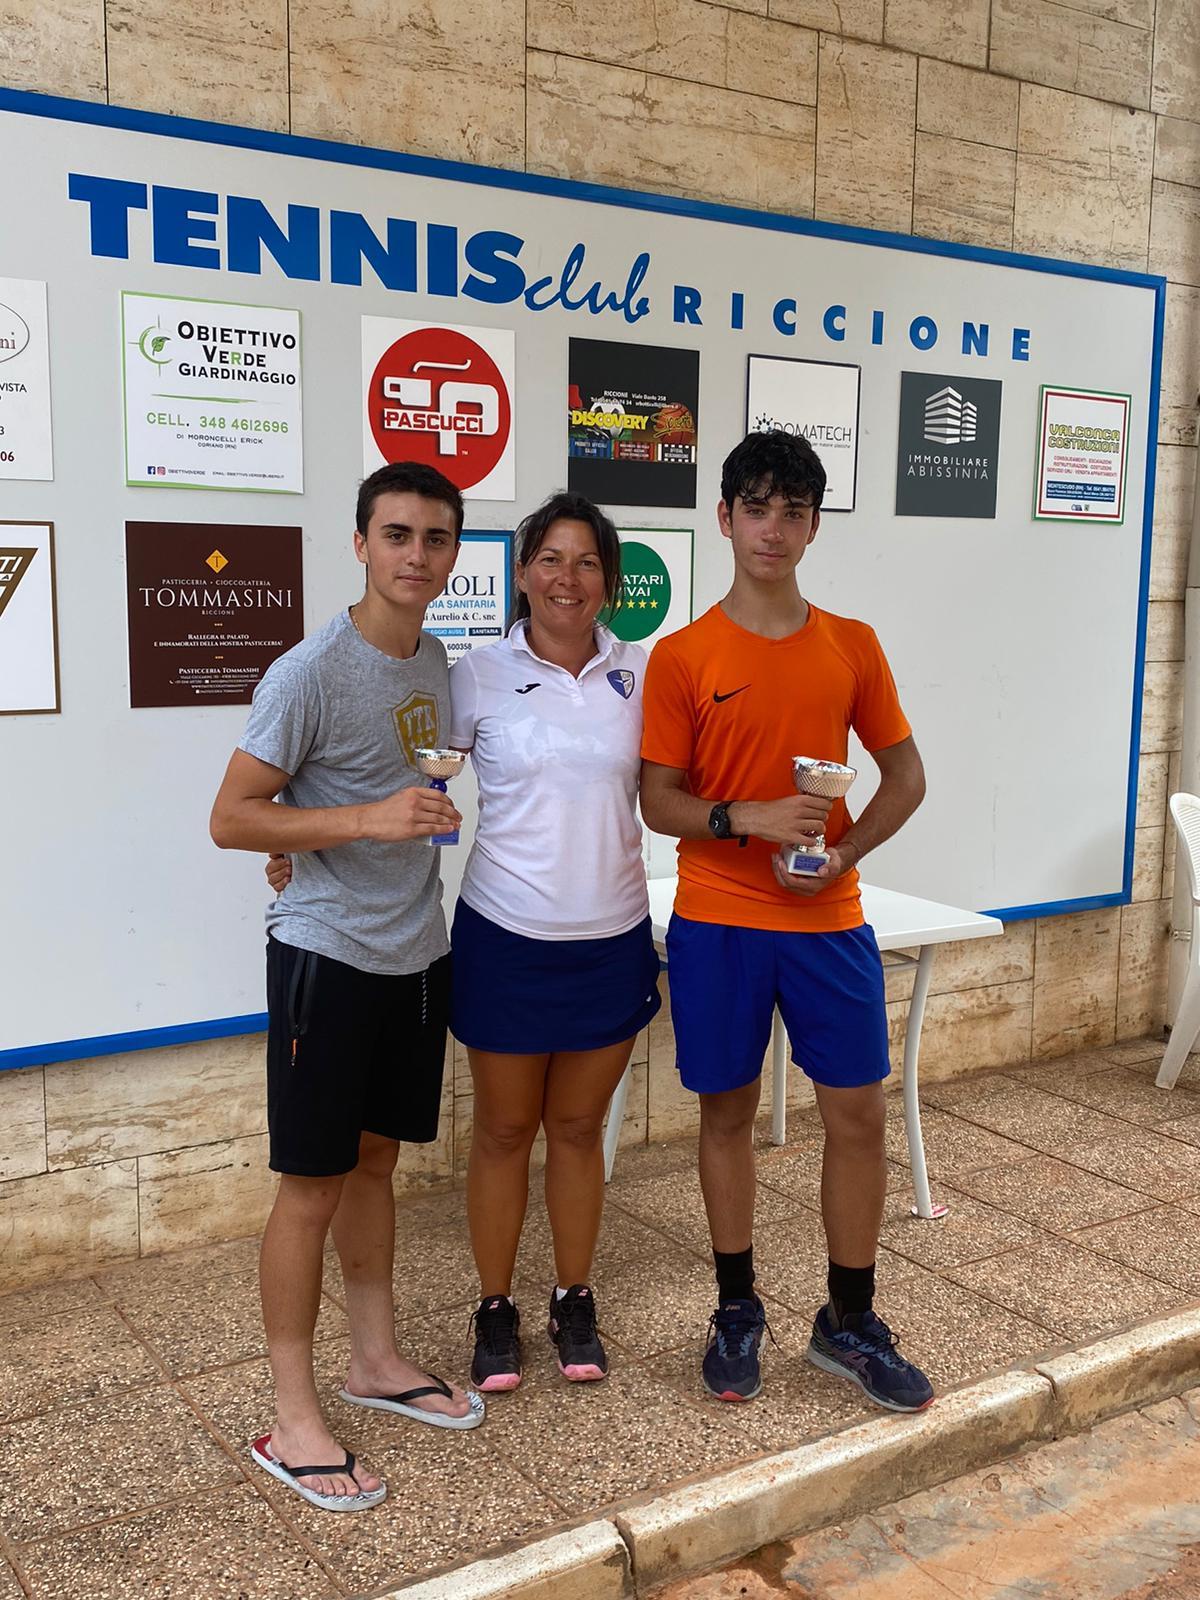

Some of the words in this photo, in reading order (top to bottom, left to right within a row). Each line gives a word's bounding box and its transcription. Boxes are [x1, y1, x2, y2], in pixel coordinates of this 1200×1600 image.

[68, 173, 526, 304] TENNIS
[524, 243, 650, 324] club
[673, 285, 1031, 362] RICCIONE
[177, 321, 297, 350] OBIETTIVO
[202, 344, 266, 368] VERDE
[178, 362, 296, 385] GIARDINAGGIO
[603, 390, 629, 399] RICCIONE
[146, 412, 190, 427] CELL.
[199, 416, 226, 429] 348
[231, 419, 289, 434] 4612696
[385, 410, 483, 433] PASCUCCI
[572, 410, 649, 430] DISCOVERY
[188, 434, 237, 443] MORONCELLI
[240, 437, 264, 445] ERICK
[774, 422, 852, 442] DOMATECH
[1049, 424, 1120, 441] VALCONCA
[908, 454, 988, 467] IMMOBILIARE
[907, 465, 989, 480] ABISSINIA
[139, 587, 293, 608] TOMMASINI
[446, 600, 497, 609] SANITARIA
[431, 612, 460, 621] Aurelio
[462, 612, 470, 621] &
[472, 612, 482, 621] C.
[187, 633, 220, 641] RALLEGRA
[447, 643, 472, 651] 600358
